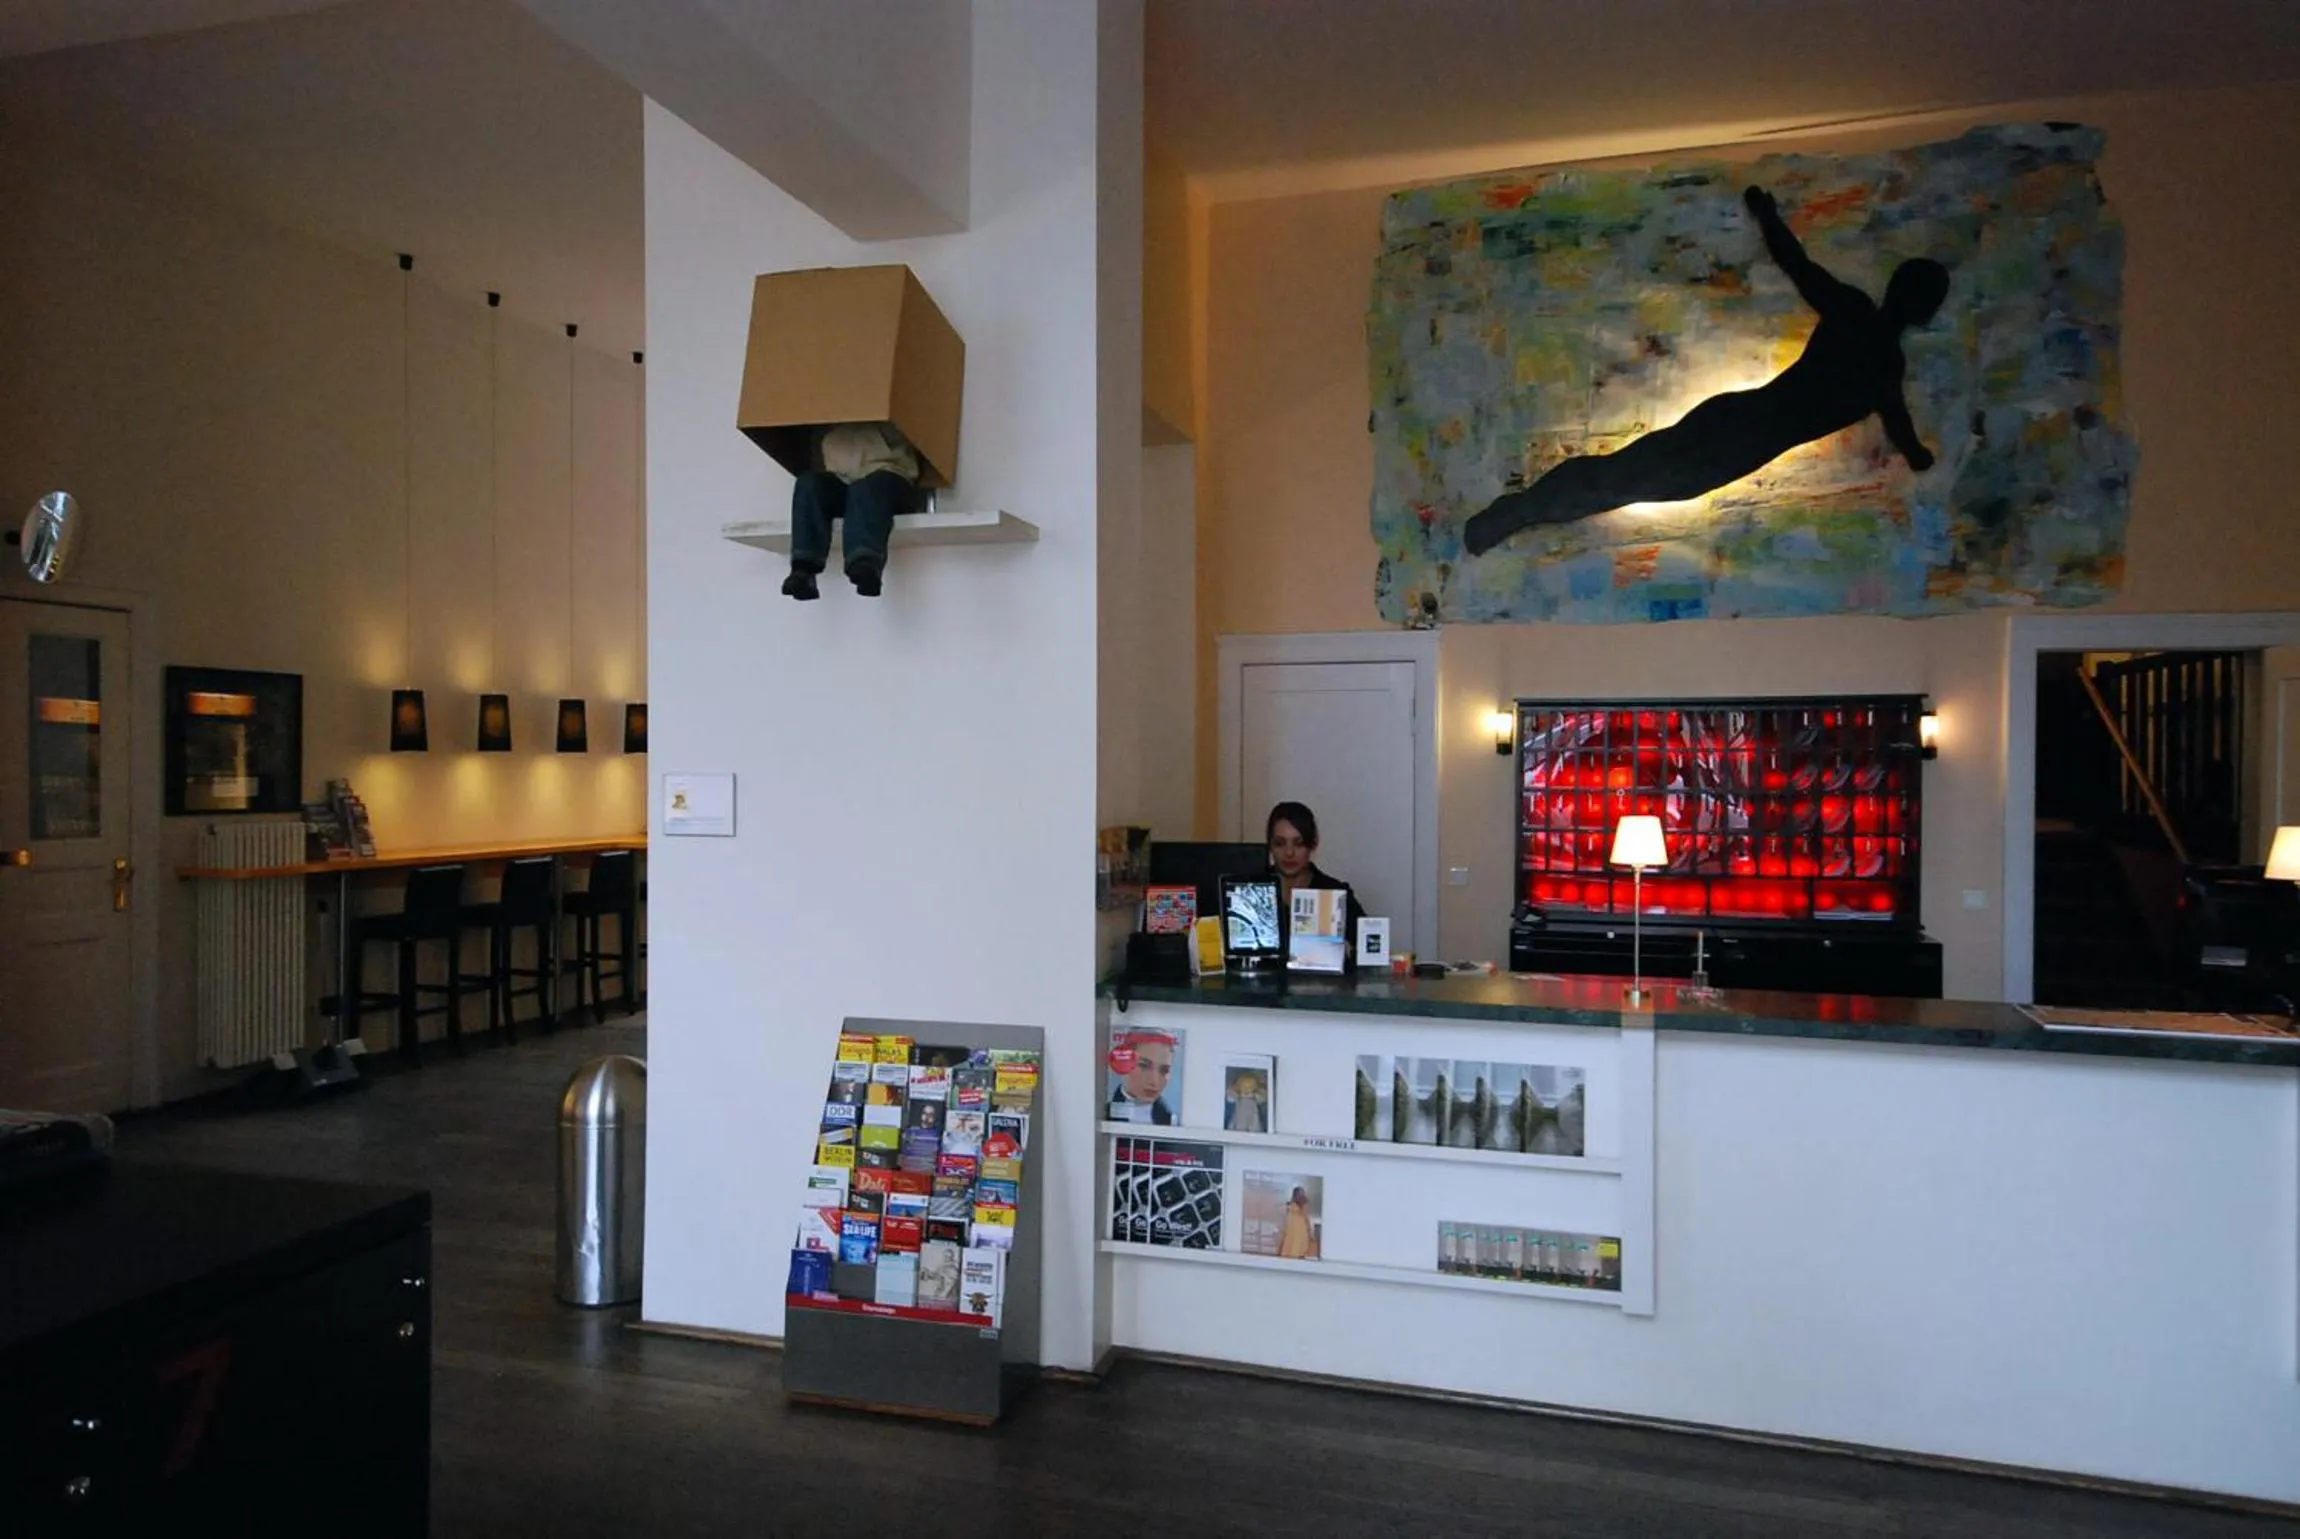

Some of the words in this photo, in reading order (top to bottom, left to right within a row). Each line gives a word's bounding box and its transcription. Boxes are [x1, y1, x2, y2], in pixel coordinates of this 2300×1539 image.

[829, 1105, 853, 1117] DDR
[843, 1223, 860, 1235] SEA
[861, 1224, 877, 1238] LIFE
